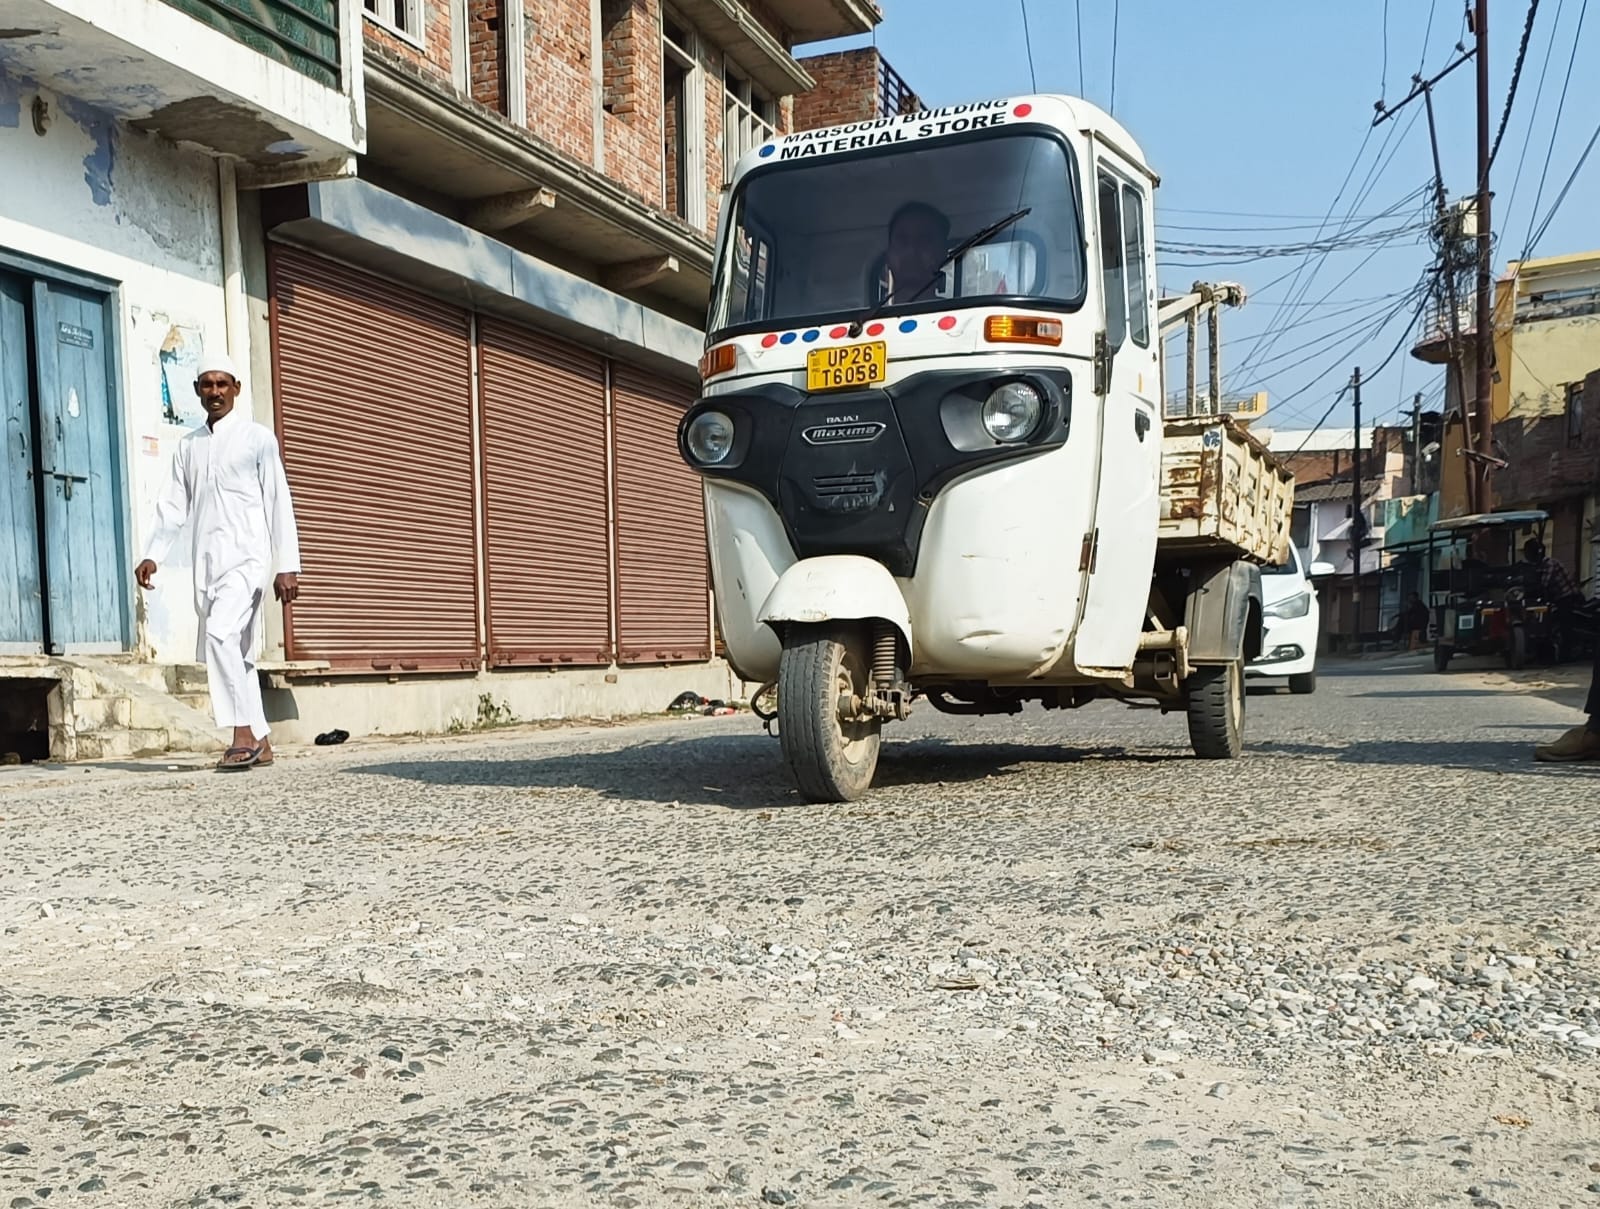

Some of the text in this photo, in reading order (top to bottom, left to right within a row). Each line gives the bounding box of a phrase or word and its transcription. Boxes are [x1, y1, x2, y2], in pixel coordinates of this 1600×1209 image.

[780, 111, 1006, 160] MATERIAL STORE
[784, 99, 1009, 143] MAQSOODI BUILDING
[822, 363, 878, 386] T6058
